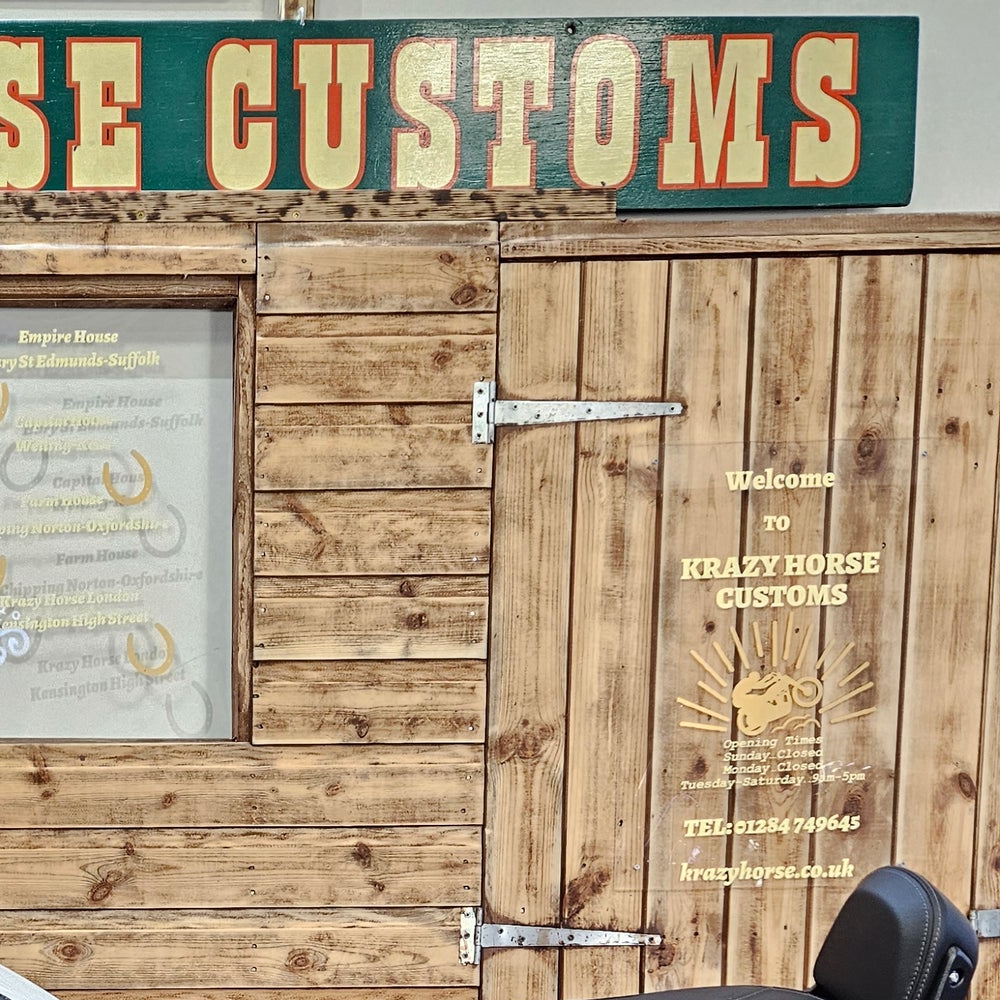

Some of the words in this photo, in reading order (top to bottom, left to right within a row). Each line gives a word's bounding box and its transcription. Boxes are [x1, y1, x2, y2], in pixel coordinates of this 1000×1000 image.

[204, 31, 861, 190] CUSTOMS
[18, 330, 71, 348] Empire
[73, 330, 119, 344] House
[18, 354, 34, 369] St
[36, 351, 160, 370] Edmunds-Suffolk
[725, 468, 835, 491] Welcome
[763, 515, 790, 531] TO
[680, 555, 781, 580] KRAZY
[783, 551, 881, 576] HORSE
[0, 595, 42, 610] Krazy
[43, 593, 87, 607] Horse
[88, 590, 139, 604] London
[716, 583, 848, 609] CUSTOMS
[71, 613, 107, 630] High
[108, 612, 149, 626] Street
[723, 738, 778, 750] Opening
[785, 735, 824, 745] Times
[793, 814, 861, 834] 749645
[680, 858, 854, 886] krazyhorse.co.uk
